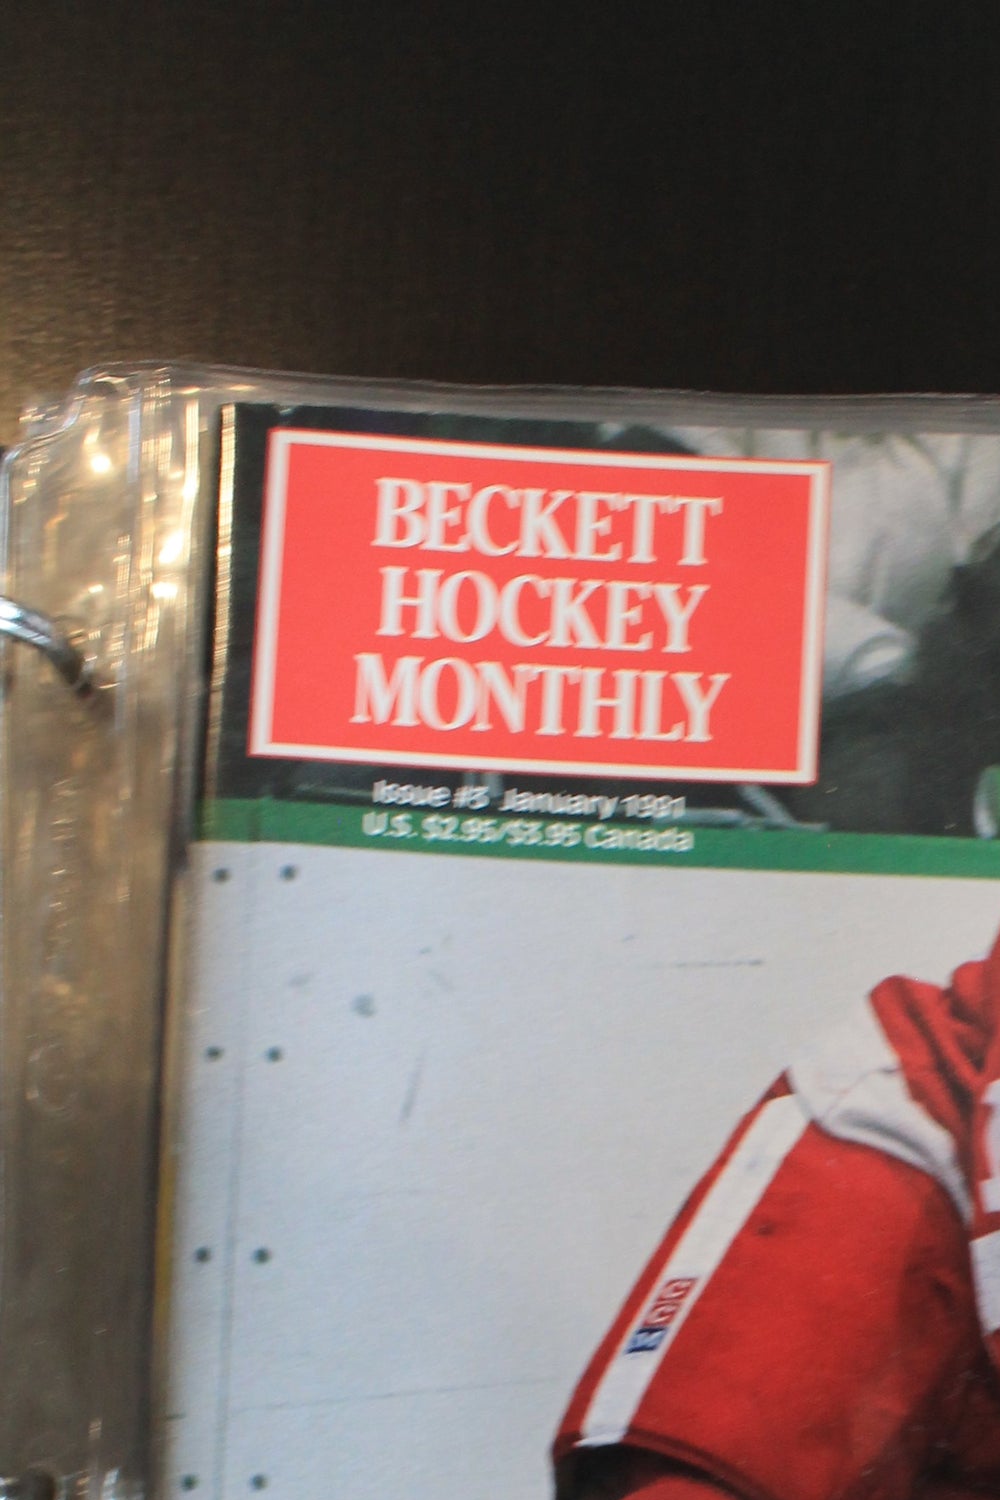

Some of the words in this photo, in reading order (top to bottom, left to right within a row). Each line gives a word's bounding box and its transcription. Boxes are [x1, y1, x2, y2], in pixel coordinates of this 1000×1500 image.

[371, 477, 723, 566] BECKETT
[375, 566, 710, 653] HOCKEY
[350, 652, 731, 743] MONTHLY
[362, 811, 418, 838] U.S.
[584, 824, 695, 852] Canada
[372, 780, 450, 807] Issue
[452, 785, 490, 810] #3
[500, 788, 620, 820] January
[620, 794, 687, 819] 1991
